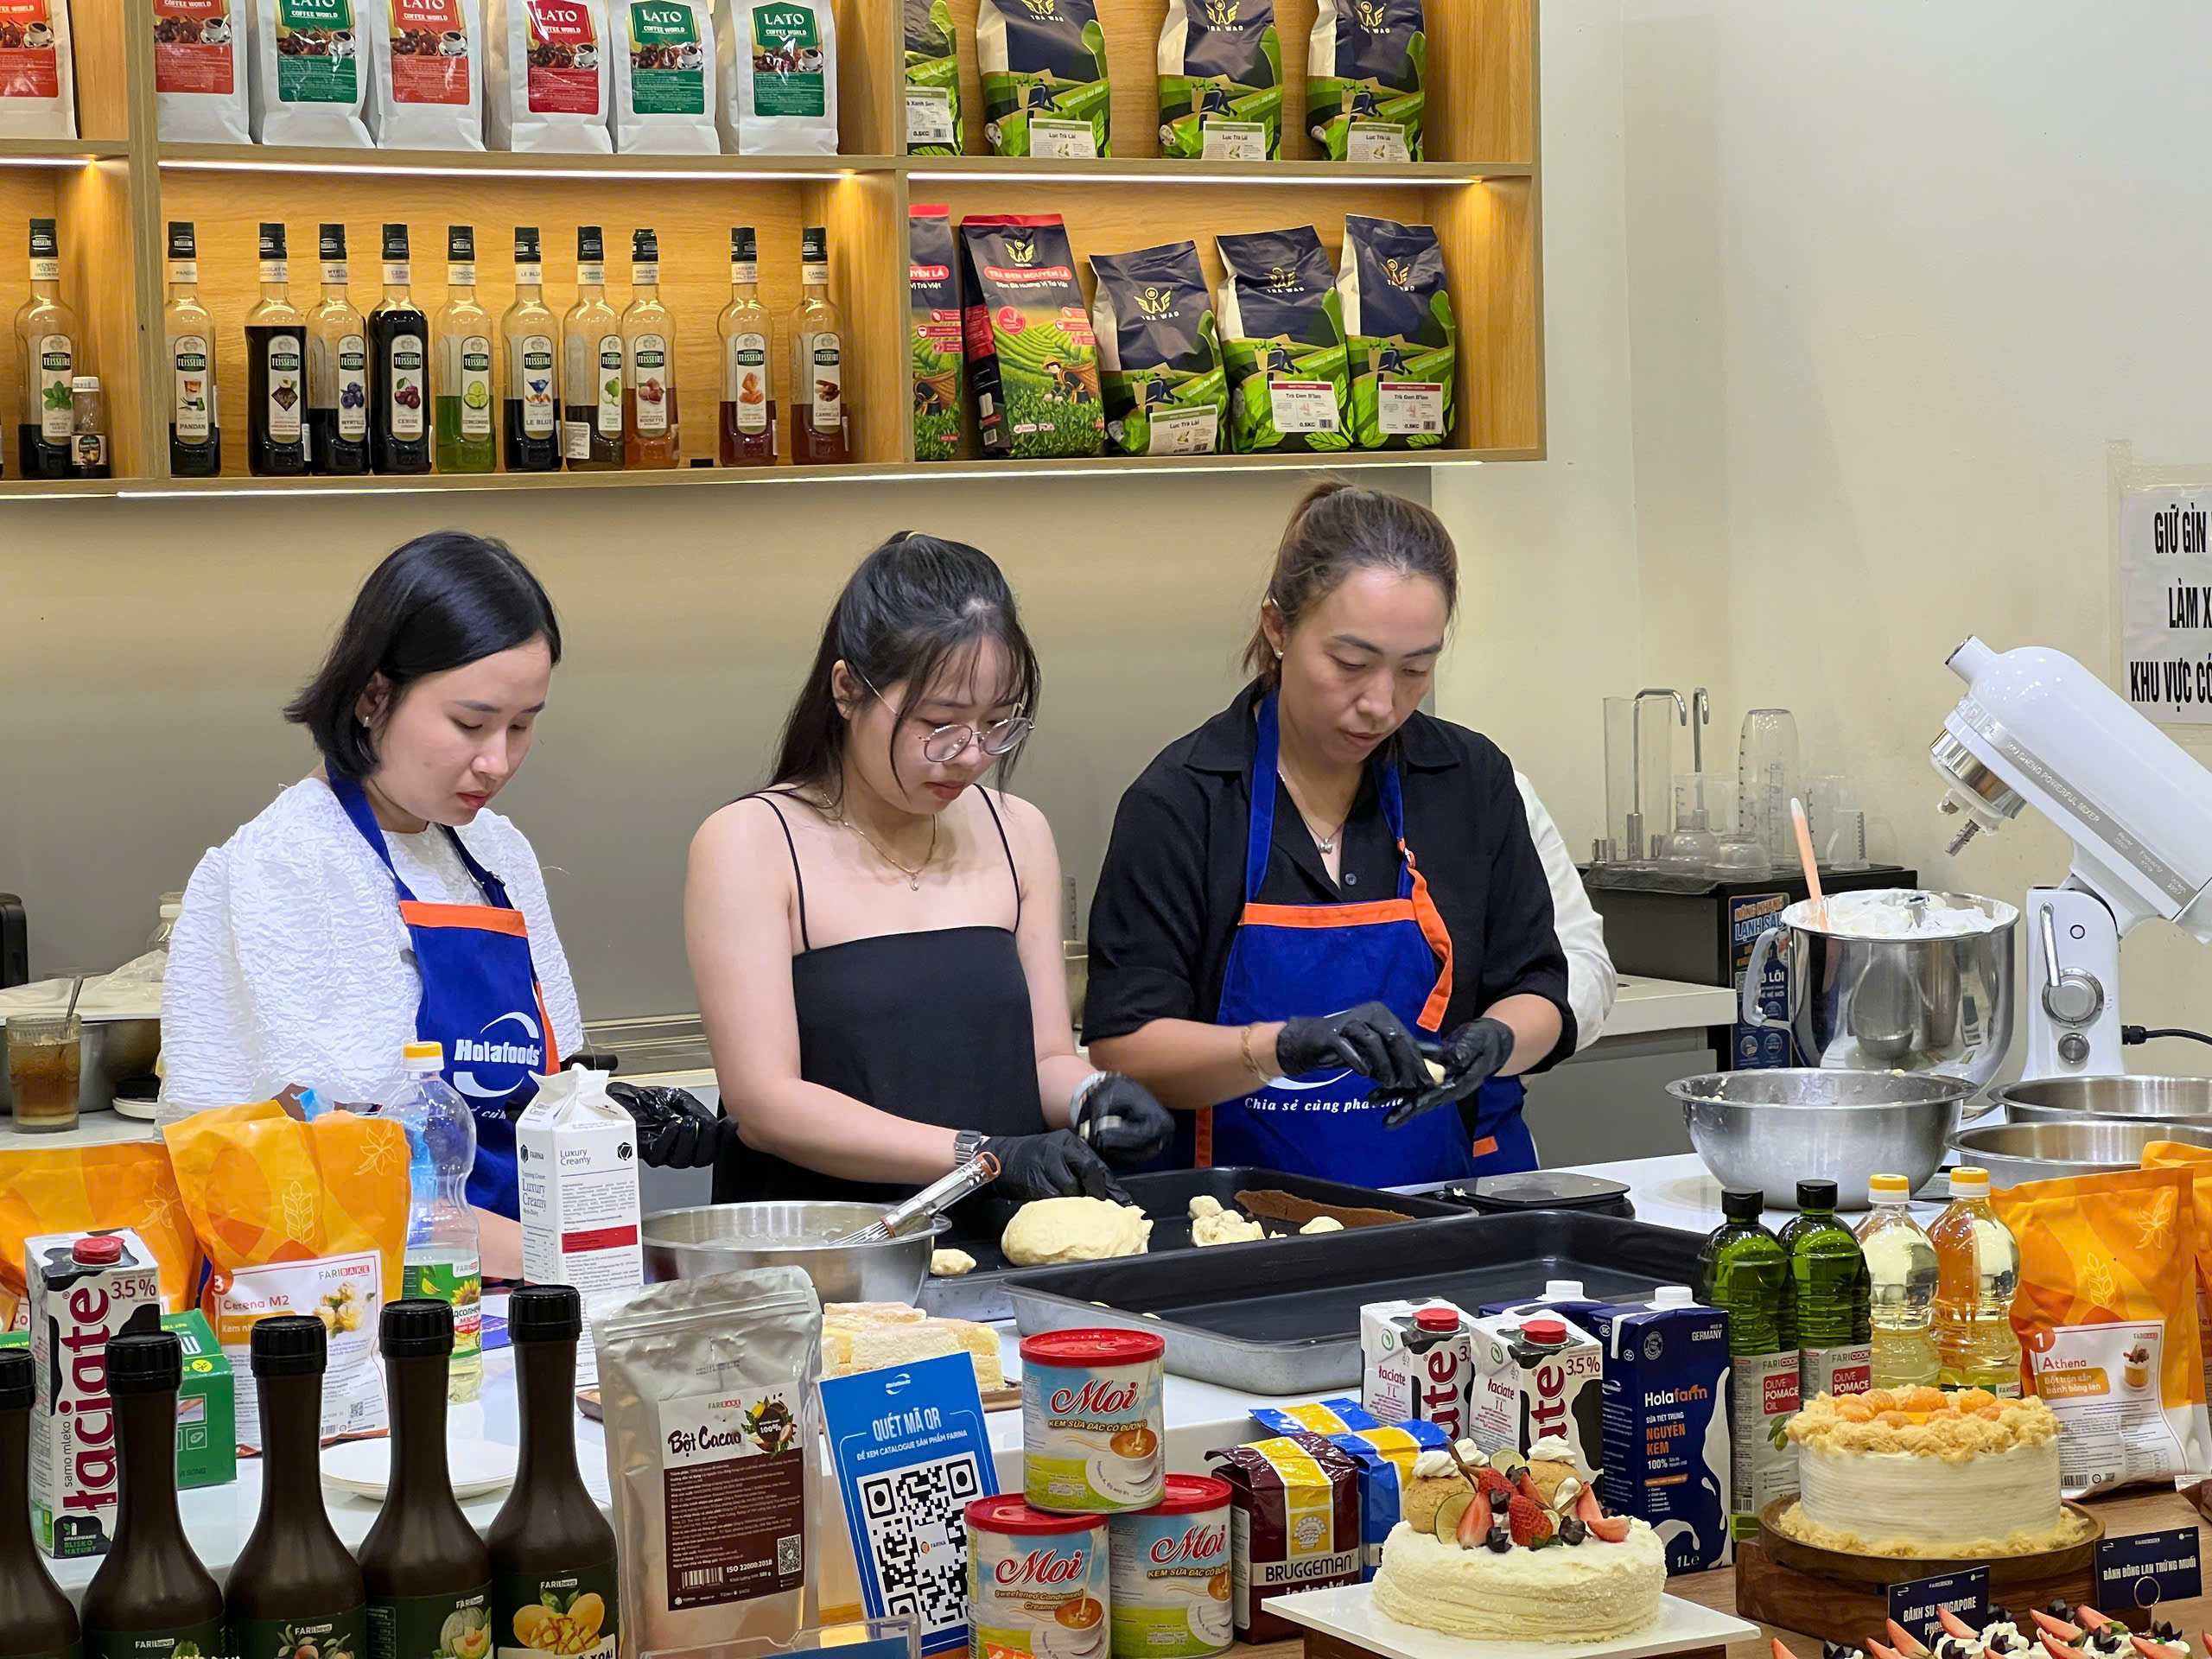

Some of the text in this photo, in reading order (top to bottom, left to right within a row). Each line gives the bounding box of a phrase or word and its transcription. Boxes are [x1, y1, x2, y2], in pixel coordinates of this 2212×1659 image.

[537, 9, 577, 22] LATO
[642, 9, 683, 23] LATO
[764, 13, 804, 27] LATO
[2154, 502, 2207, 554] GIỮ GÌN
[2168, 577, 2198, 629] LÀM
[2130, 661, 2159, 702] KHU
[2163, 657, 2192, 712] VỰC
[454, 1039, 540, 1066] Holafoods
[1244, 1096, 1276, 1111] Chia
[1282, 1098, 1299, 1111] sẻ
[1304, 1098, 1339, 1113] cùng
[560, 1149, 588, 1159] Luxury
[560, 1156, 591, 1166] Creamy
[522, 1178, 546, 1198] Luxury
[523, 1192, 547, 1212] Creamy
[318, 1264, 371, 1280] FARIBAKE
[269, 1294, 289, 1308] M2
[222, 1322, 240, 1332] Kem
[1691, 1330, 1722, 1341] GERMANY
[2035, 1332, 2044, 1349] 1
[1831, 1350, 1871, 1363] FARICOOK
[2043, 1357, 2087, 1370] Athena
[1764, 1377, 1787, 1390] OLIVE
[1834, 1370, 1857, 1382] OLIVE
[1764, 1386, 1799, 1401] POMACE
[1834, 1379, 1870, 1394] POMACE
[2046, 1385, 2068, 1395] bánh
[1051, 1379, 1140, 1416] Moi
[1644, 1384, 1708, 1408] Holafarm
[1764, 1402, 1777, 1412] OIL
[760, 1424, 782, 1434] 100%
[872, 1406, 942, 1442] QUÉT MÃ QR
[61, 1421, 72, 1455] mleko
[667, 1426, 742, 1458] Bột Cacao
[866, 1448, 879, 1459] XEM
[879, 1440, 915, 1456] CATALOGUE
[946, 1429, 968, 1443] FARINA
[1646, 1441, 1669, 1456] KEM
[1647, 1458, 1669, 1470] 100%
[63, 1457, 73, 1488] samo
[1149, 1524, 1228, 1564] Moi
[727, 1565, 739, 1573] ISO
[995, 1549, 1085, 1585] Moi
[1147, 1567, 1167, 1579] KEM
[1265, 1554, 1352, 1583] BRUGGEMAN
[2103, 1567, 2121, 1581] BÁNH
[2141, 1563, 2154, 1575] LAN
[995, 1588, 1084, 1600] Sweetened Condensed
[1024, 1601, 1059, 1611] Creamer
[1903, 1606, 1923, 1623] BÁNH
[1924, 1604, 1935, 1618] SU
